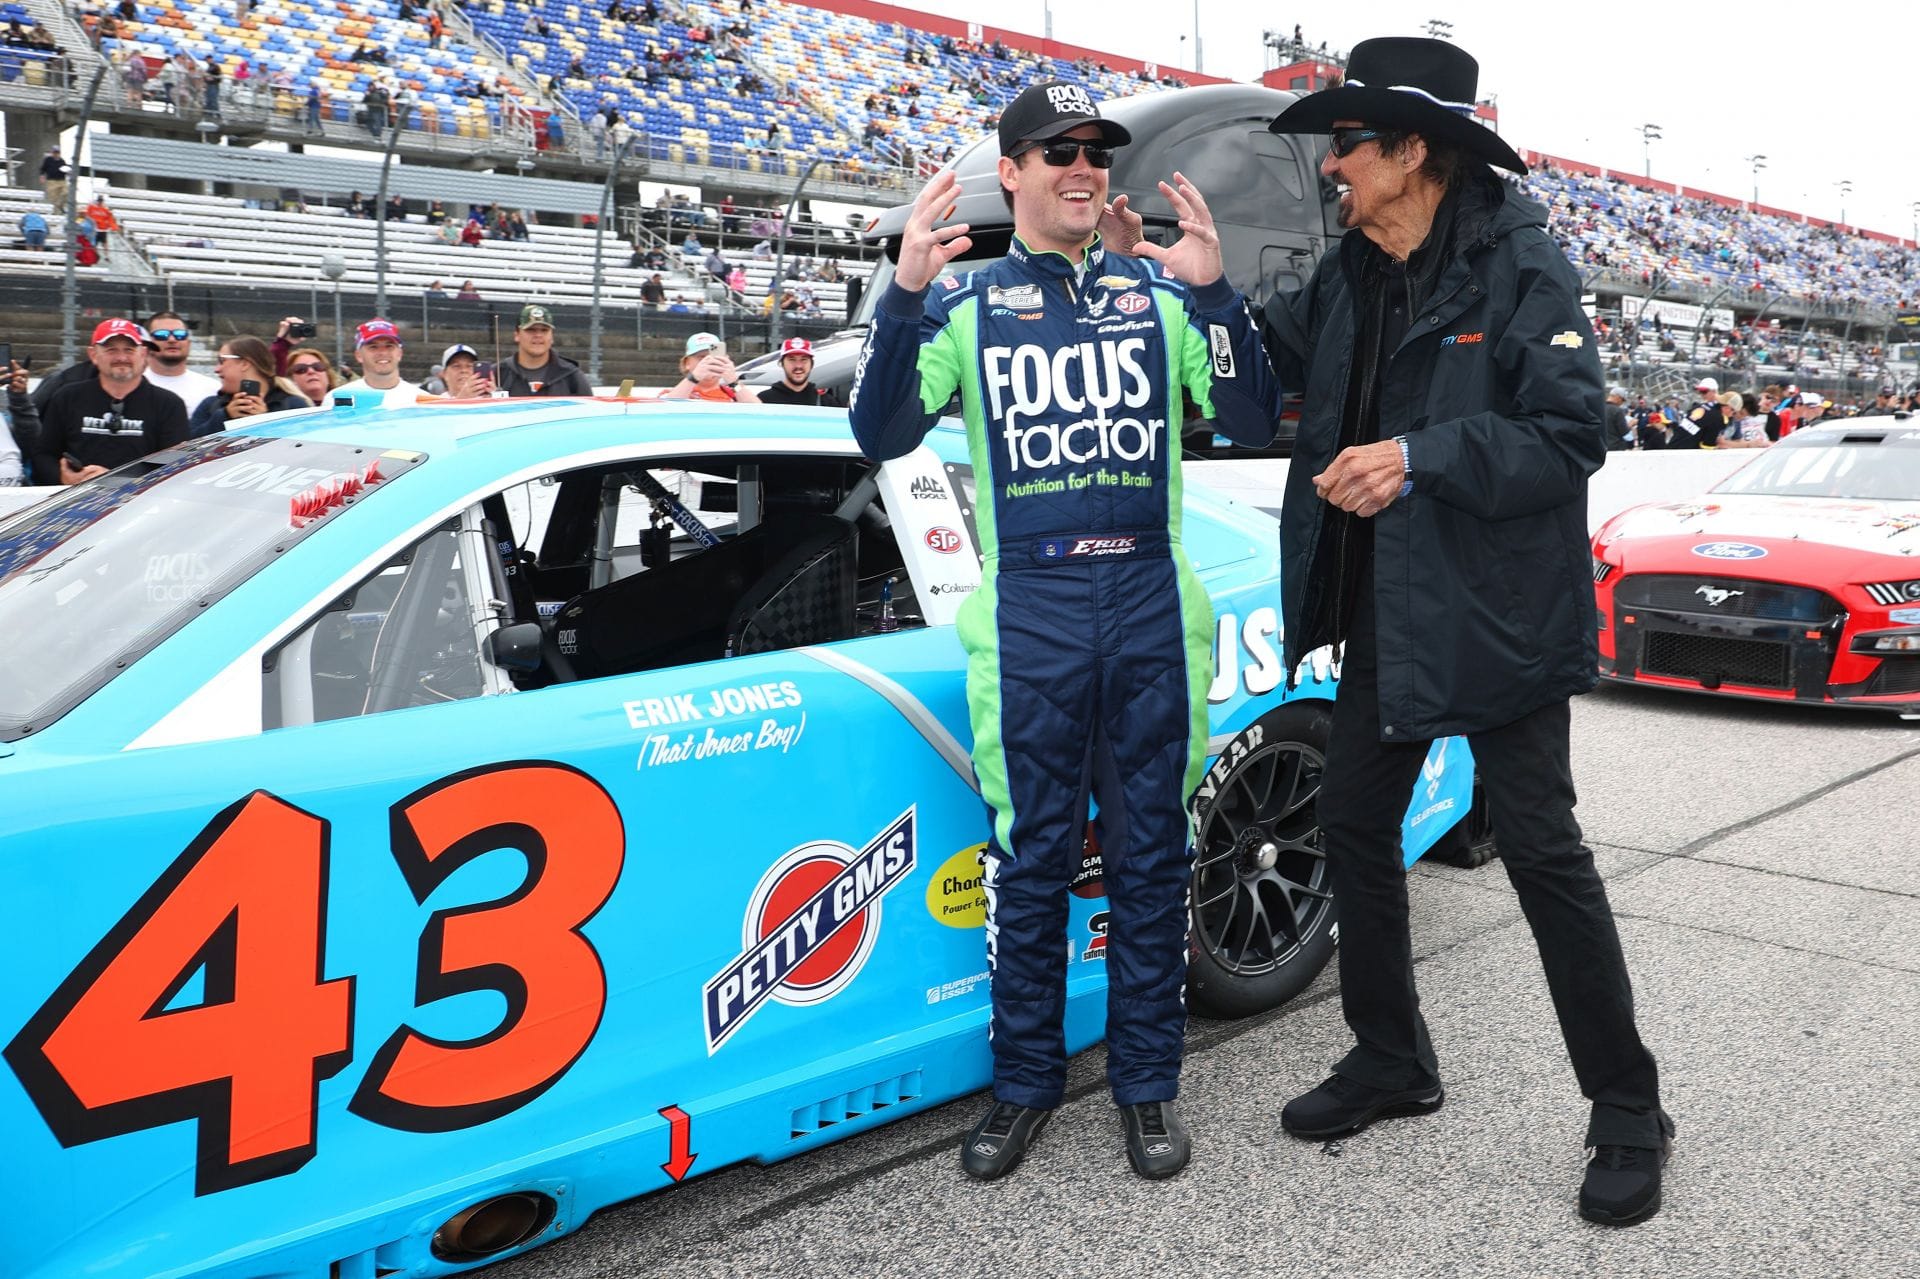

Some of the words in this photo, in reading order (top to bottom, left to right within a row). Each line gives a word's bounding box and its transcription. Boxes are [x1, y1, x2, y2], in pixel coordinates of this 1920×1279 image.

[1120, 296, 1146, 312] STP
[1097, 321, 1155, 333] GOODYEAR
[984, 338, 1151, 420] FOCUS
[1003, 403, 1165, 471] factor
[911, 475, 945, 493] MAC
[1006, 477, 1065, 498] Nutrition
[1068, 472, 1094, 491] for
[1097, 468, 1119, 486] the
[1122, 471, 1152, 487] Brain
[676, 511, 707, 540] FOCUS
[930, 530, 959, 550] STP
[1070, 536, 1136, 554] ERIK
[1708, 543, 1755, 558] Ford
[144, 552, 210, 583] FOCUS
[558, 629, 577, 645] FOCUS
[623, 693, 704, 729] ERIK
[708, 680, 802, 718] JONES
[637, 732, 696, 771] (That
[695, 728, 753, 760] Jones
[755, 711, 806, 753] Boy)
[1082, 855, 1102, 868] GM
[943, 901, 973, 915] Power
[717, 898, 824, 1028] PETTY
[833, 831, 906, 923] GMS
[3, 759, 626, 1198] 43
[941, 971, 990, 993] SUPERIOR
[941, 983, 976, 1000] ESSEX
